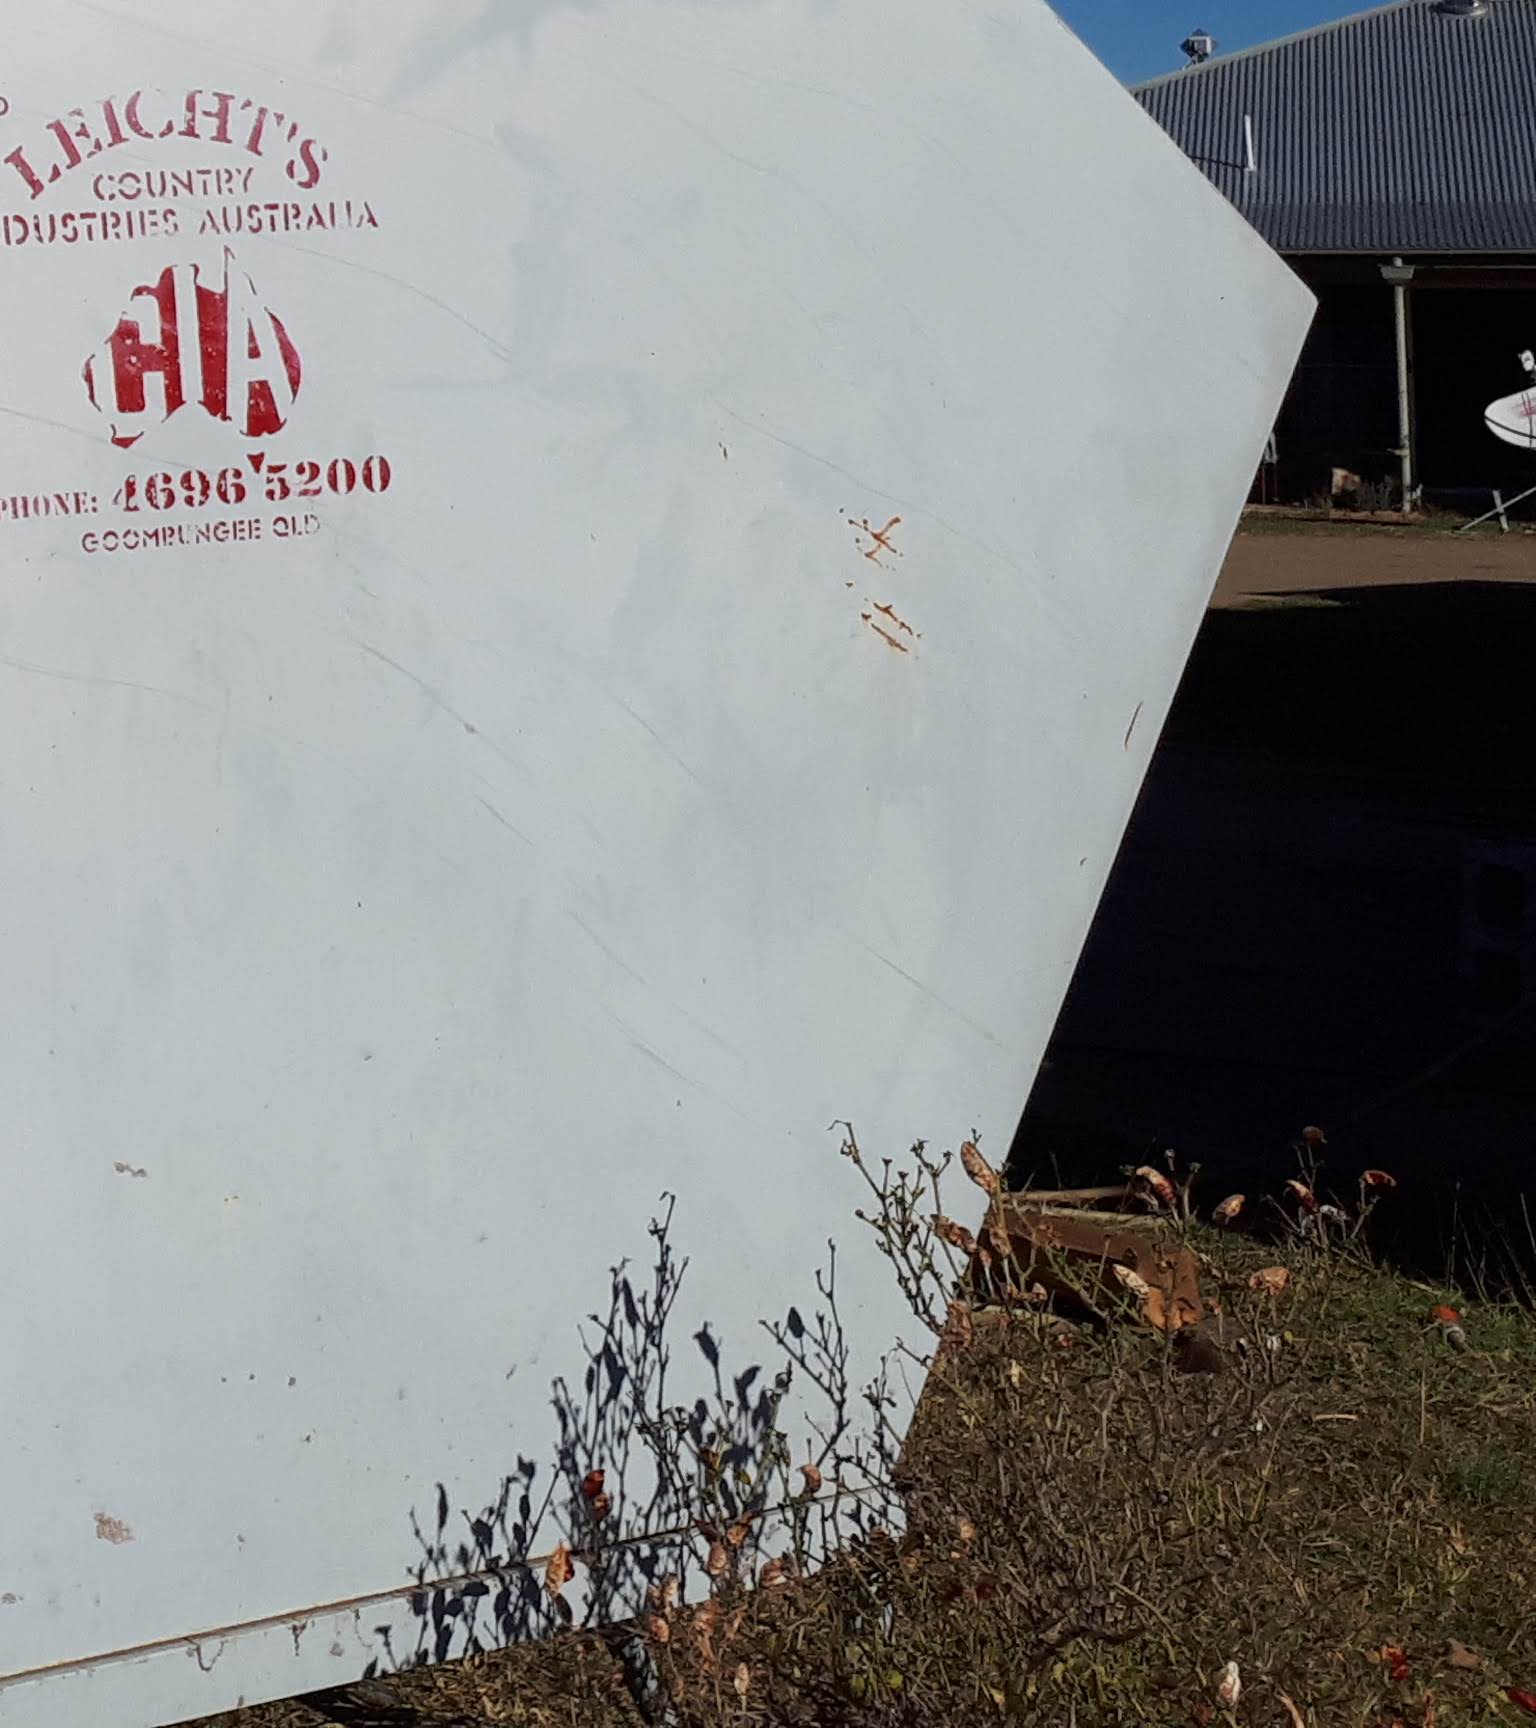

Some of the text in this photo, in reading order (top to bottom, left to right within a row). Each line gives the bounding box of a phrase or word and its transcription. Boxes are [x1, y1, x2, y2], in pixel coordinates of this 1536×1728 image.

[93, 167, 253, 200] COUNTRY
[199, 201, 379, 235] AUSTRALIA
[272, 513, 321, 537] QLD
